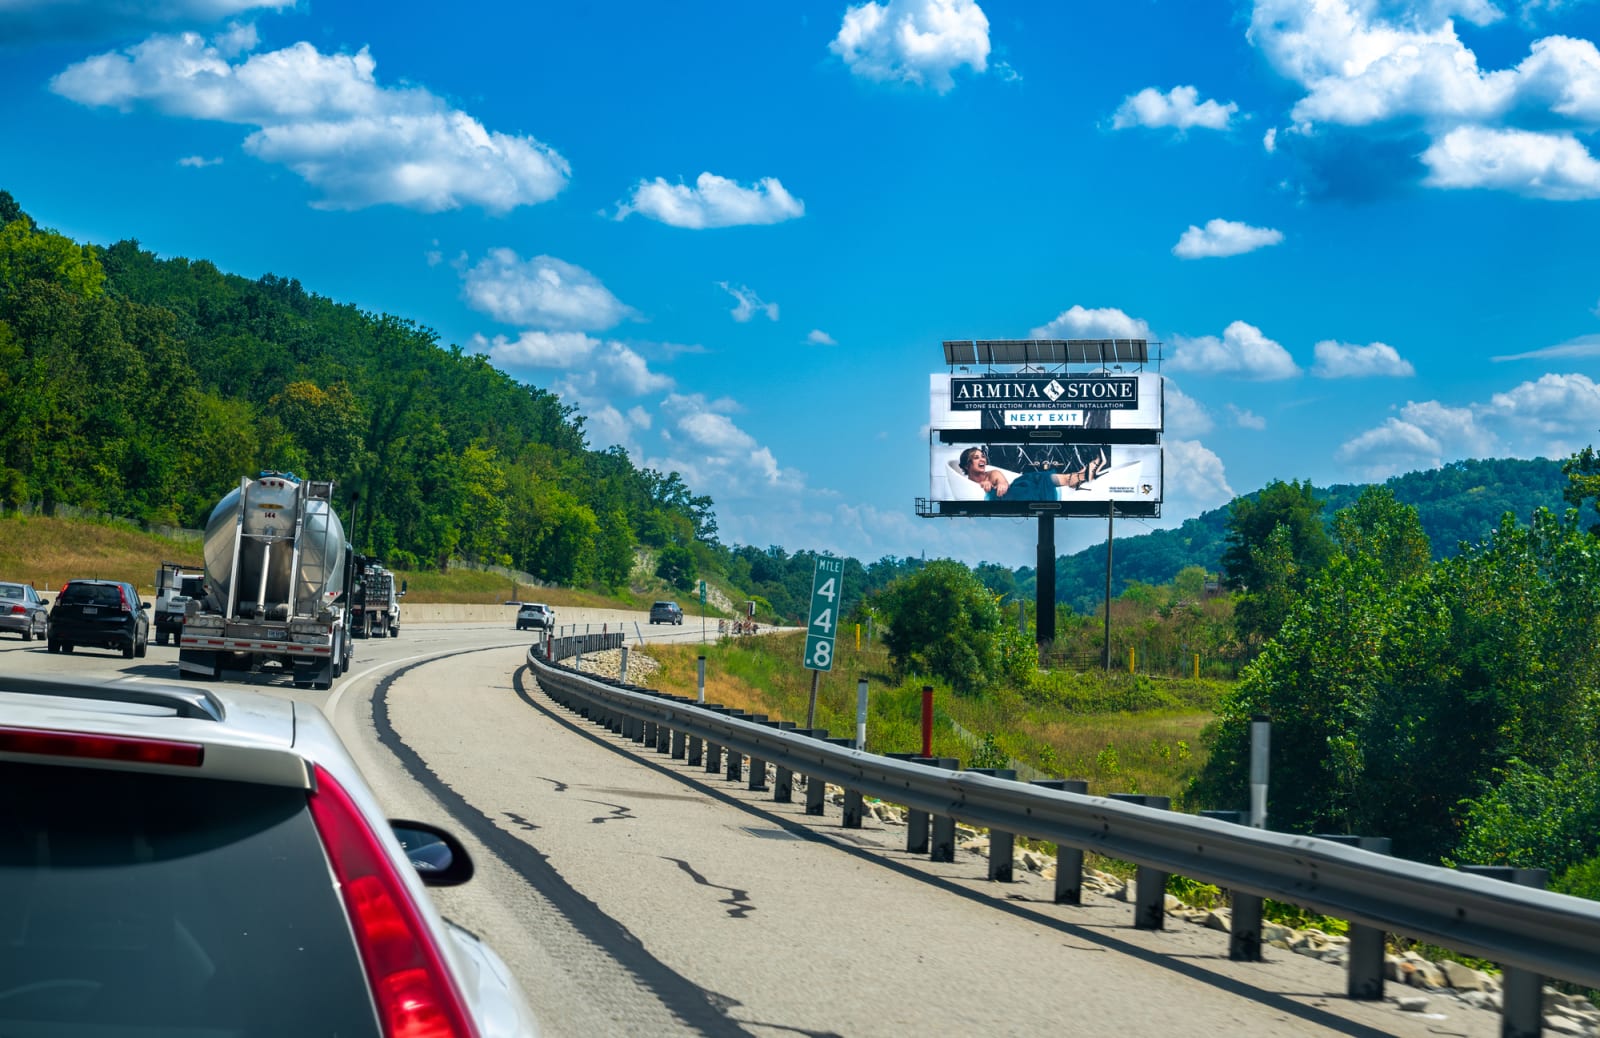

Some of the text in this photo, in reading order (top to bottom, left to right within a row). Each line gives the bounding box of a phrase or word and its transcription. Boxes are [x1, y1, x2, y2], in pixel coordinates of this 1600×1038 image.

[957, 383, 1133, 398] ARMINA STONE
[1010, 413, 1078, 422] NEXT EXIT
[818, 559, 840, 573] MILE
